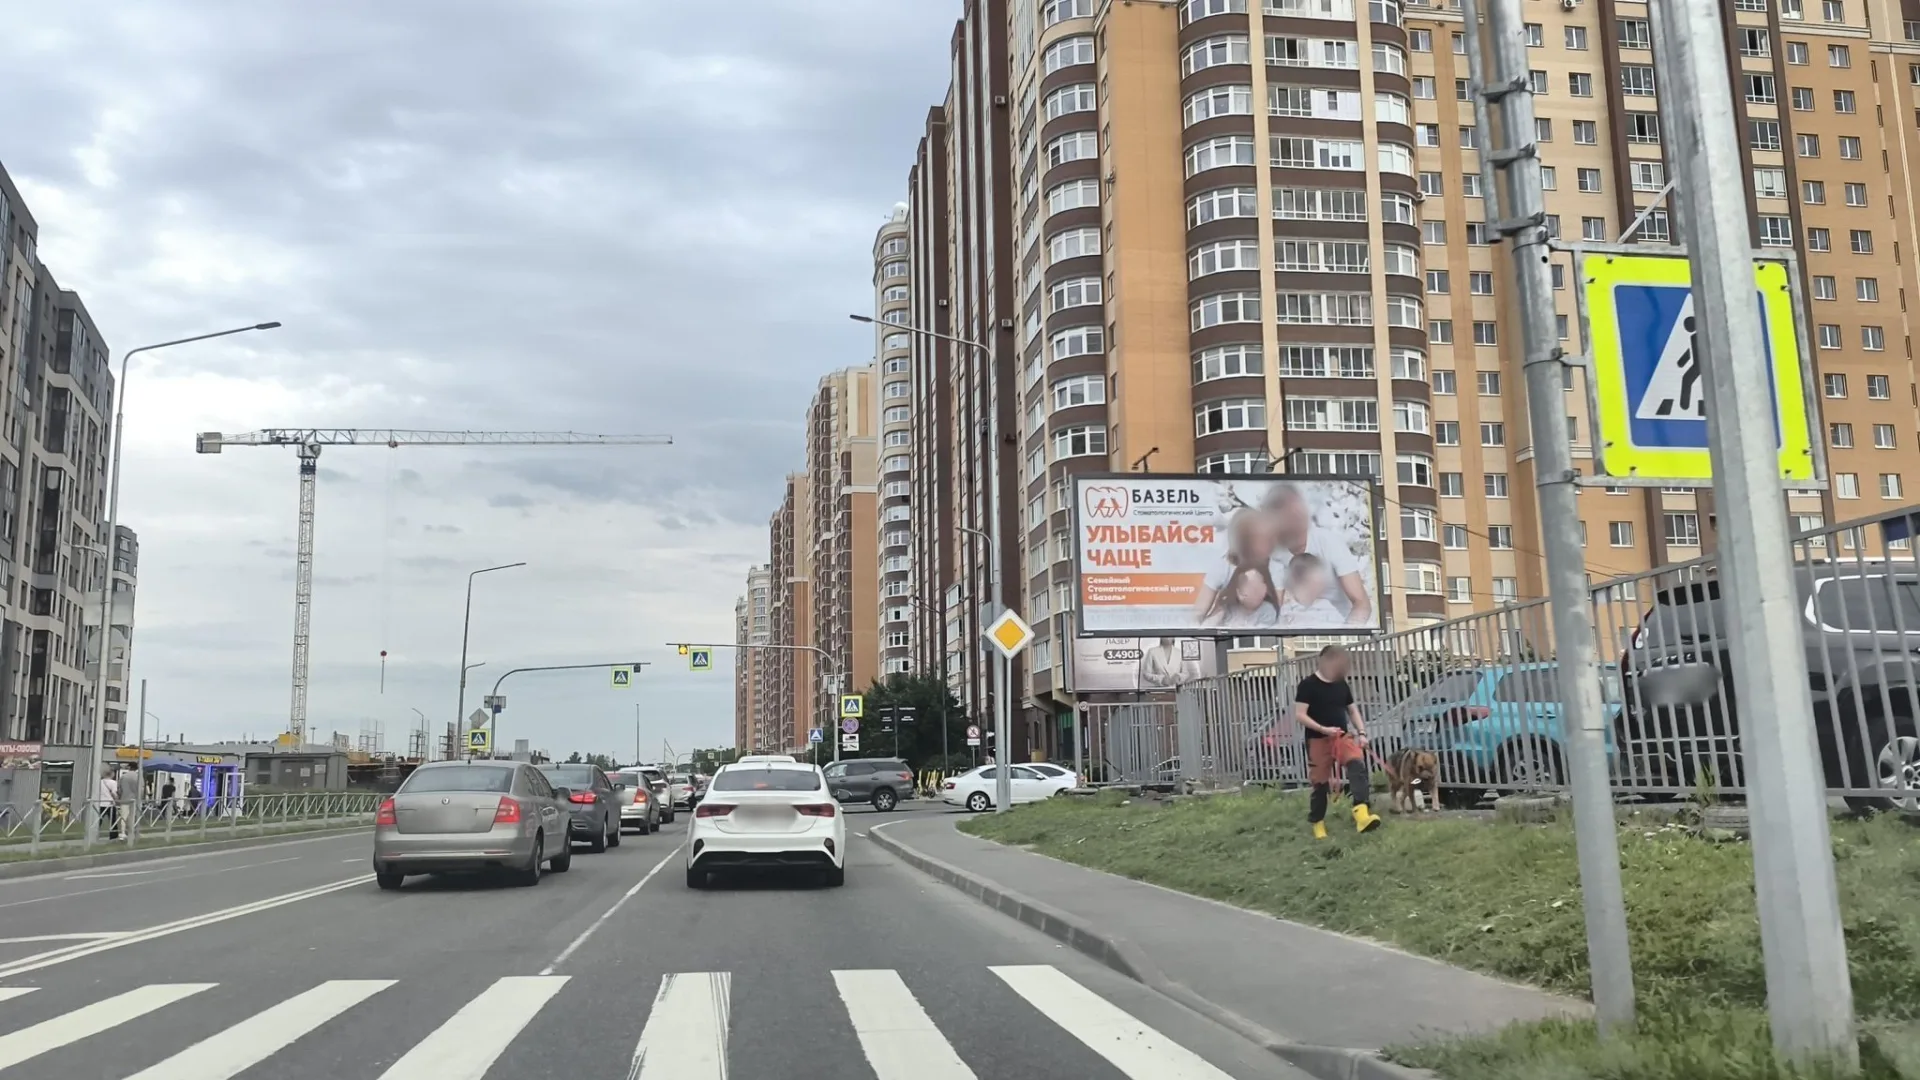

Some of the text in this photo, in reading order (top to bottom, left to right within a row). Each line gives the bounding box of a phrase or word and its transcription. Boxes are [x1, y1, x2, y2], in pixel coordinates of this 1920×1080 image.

[1132, 489, 1200, 503] БАЗЕЛЬ
[1086, 520, 1214, 543] УЛЫБАЙСЯ
[1087, 549, 1152, 568] ЧАЩЕ
[1087, 576, 1130, 584] Семейный
[1088, 585, 1195, 594] Стоматологический центр
